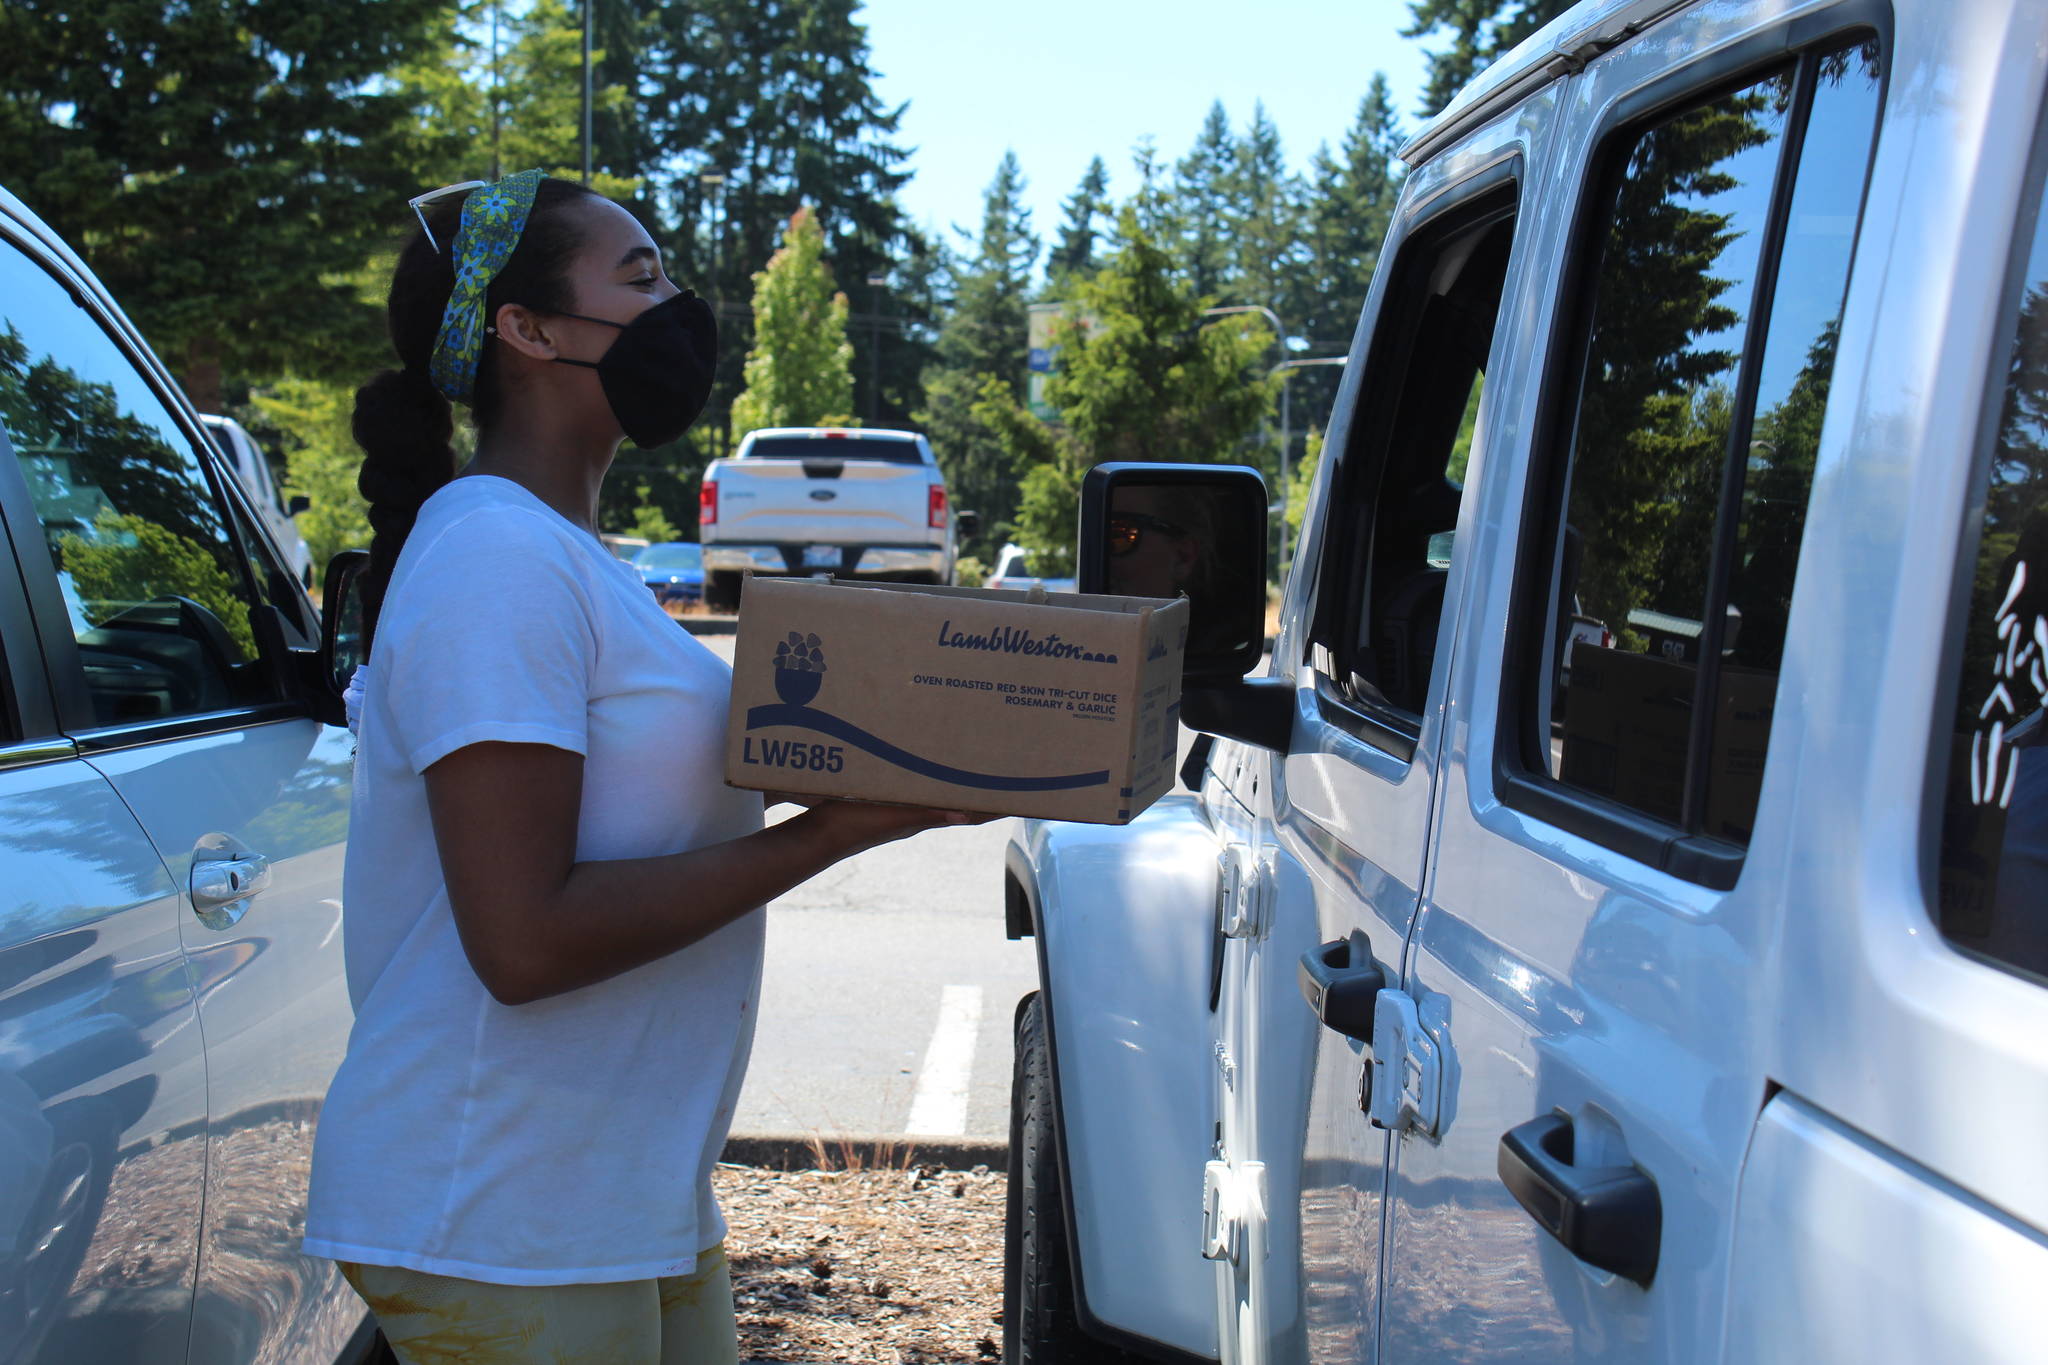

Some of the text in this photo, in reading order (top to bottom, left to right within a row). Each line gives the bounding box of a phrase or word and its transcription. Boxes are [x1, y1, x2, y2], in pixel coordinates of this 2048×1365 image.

[913, 674, 1117, 704] OVEN ROASTED RED SKIN TRI-CUT DICE
[1005, 695, 1117, 715] ROSEMARY & GARLIC
[743, 737, 844, 774] LW585
